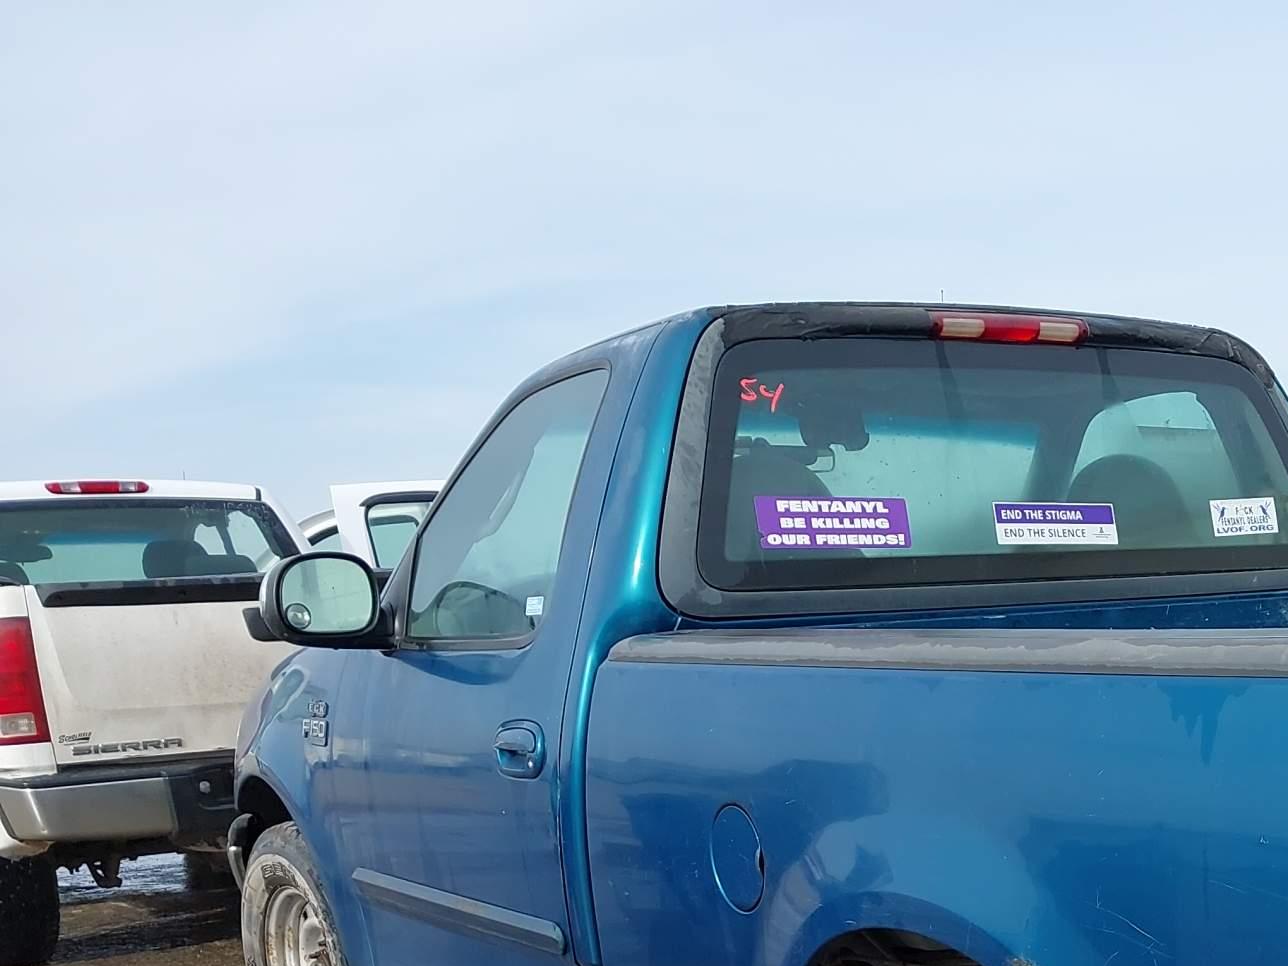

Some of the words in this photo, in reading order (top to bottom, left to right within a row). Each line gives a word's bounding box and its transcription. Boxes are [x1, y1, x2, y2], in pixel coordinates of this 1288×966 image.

[775, 499, 889, 514] FENTANYL
[1000, 509, 1022, 520] END
[1024, 509, 1044, 520] THE
[1045, 510, 1083, 521] STIGMA
[779, 517, 806, 529] BE
[811, 517, 890, 530] KILLING
[1216, 524, 1274, 534] LVOF.ORG
[766, 533, 811, 546] OUR
[816, 533, 905, 546] FRIENDS!
[1004, 528, 1025, 538] END
[1026, 528, 1046, 538] THE
[1048, 528, 1086, 538] SILENCE
[71, 737, 183, 756] SIERRA
